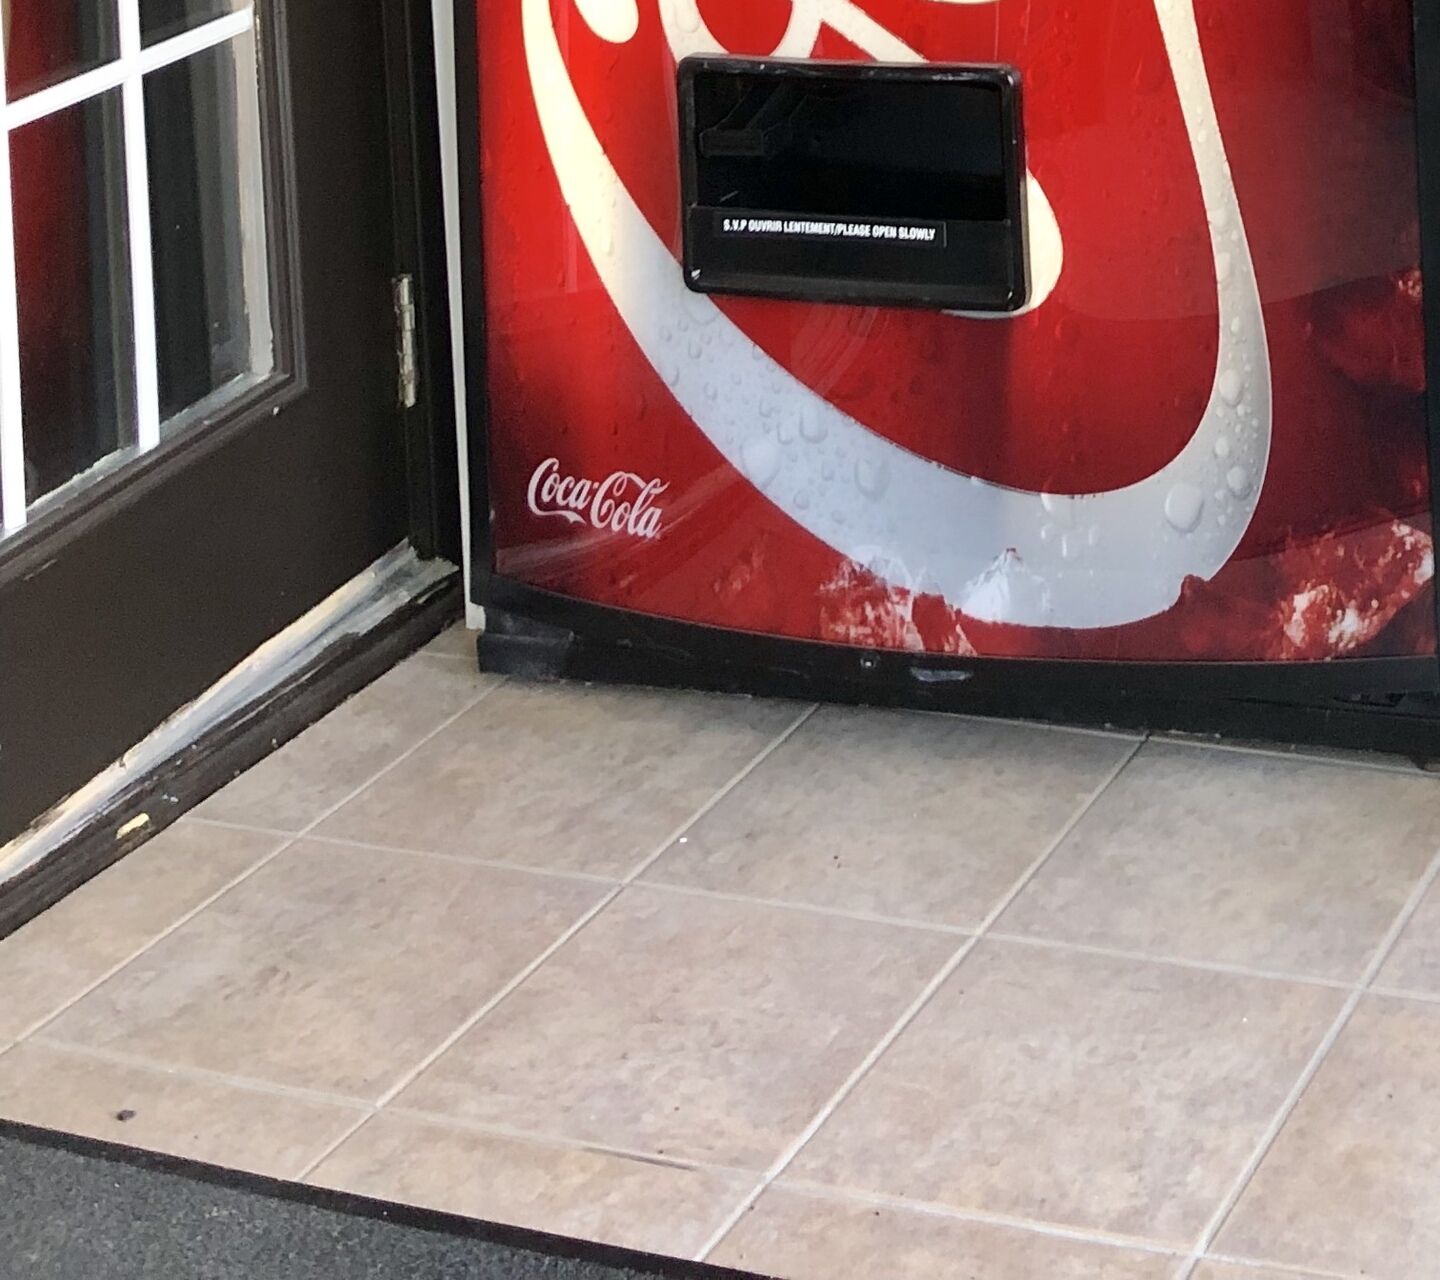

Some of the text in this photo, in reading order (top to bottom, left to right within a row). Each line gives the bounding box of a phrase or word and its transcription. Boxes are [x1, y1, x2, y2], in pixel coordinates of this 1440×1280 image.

[749, 219, 783, 233] OUVRIR
[871, 225, 897, 239] OPEN
[898, 226, 936, 241] SLOWLY
